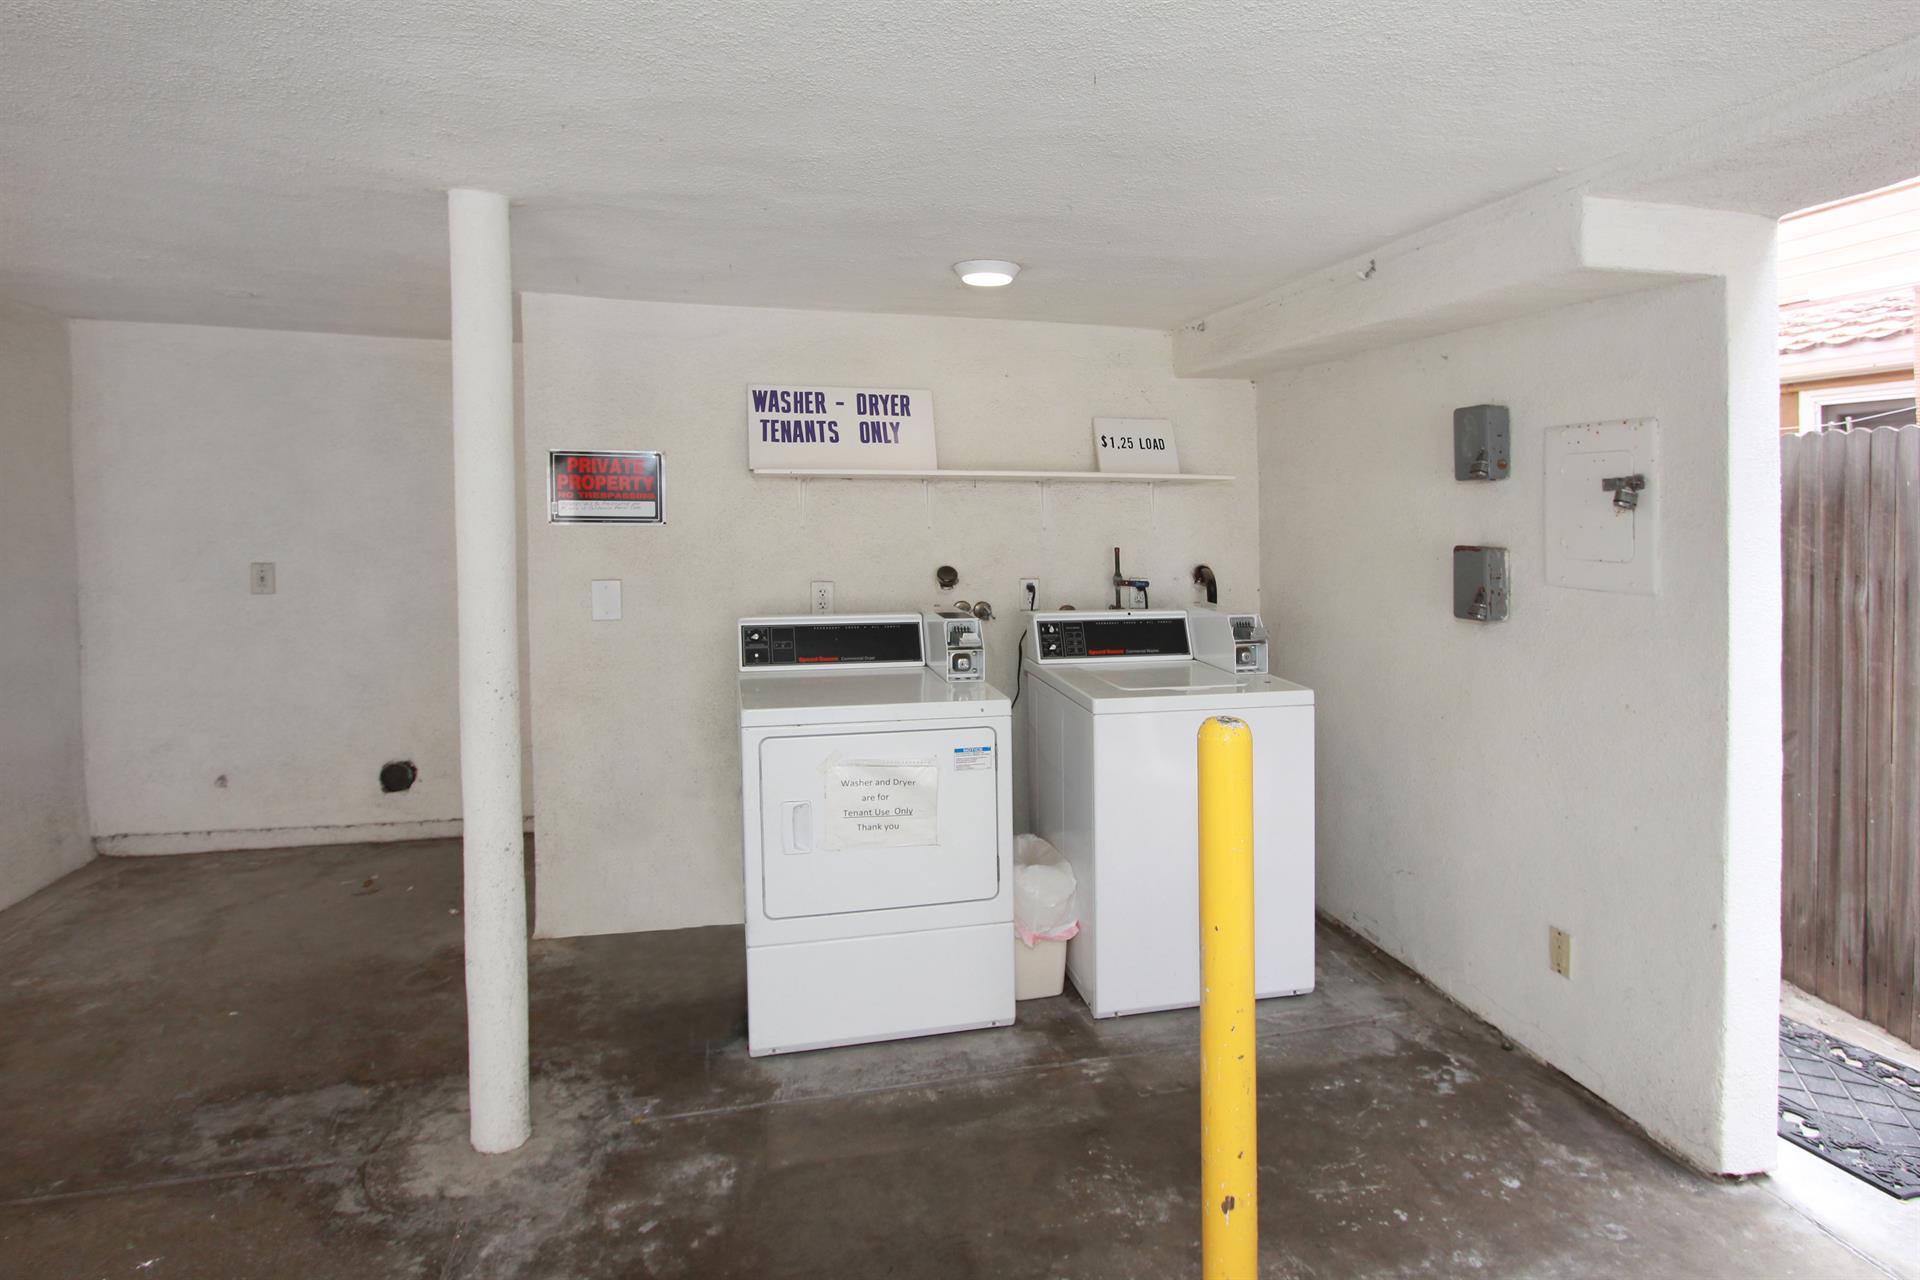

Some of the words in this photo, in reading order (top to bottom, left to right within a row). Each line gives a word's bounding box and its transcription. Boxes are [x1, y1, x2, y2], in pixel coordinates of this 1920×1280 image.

[752, 390, 827, 414] WASHER
[856, 393, 911, 416] DRYER
[759, 419, 840, 443] TENANTS
[859, 421, 901, 444] ONLY
[1139, 437, 1165, 450] LOAD
[567, 456, 645, 474] PRIVATE
[557, 473, 657, 491] PROPERTY
[840, 778, 873, 787] Washer
[875, 778, 891, 787] and
[893, 778, 916, 788] Dryer
[877, 793, 889, 801] for
[843, 808, 873, 817] Tenant
[874, 808, 890, 817] Use
[894, 807, 914, 818] Only
[857, 822, 882, 831] Thank
[883, 823, 900, 832] you
